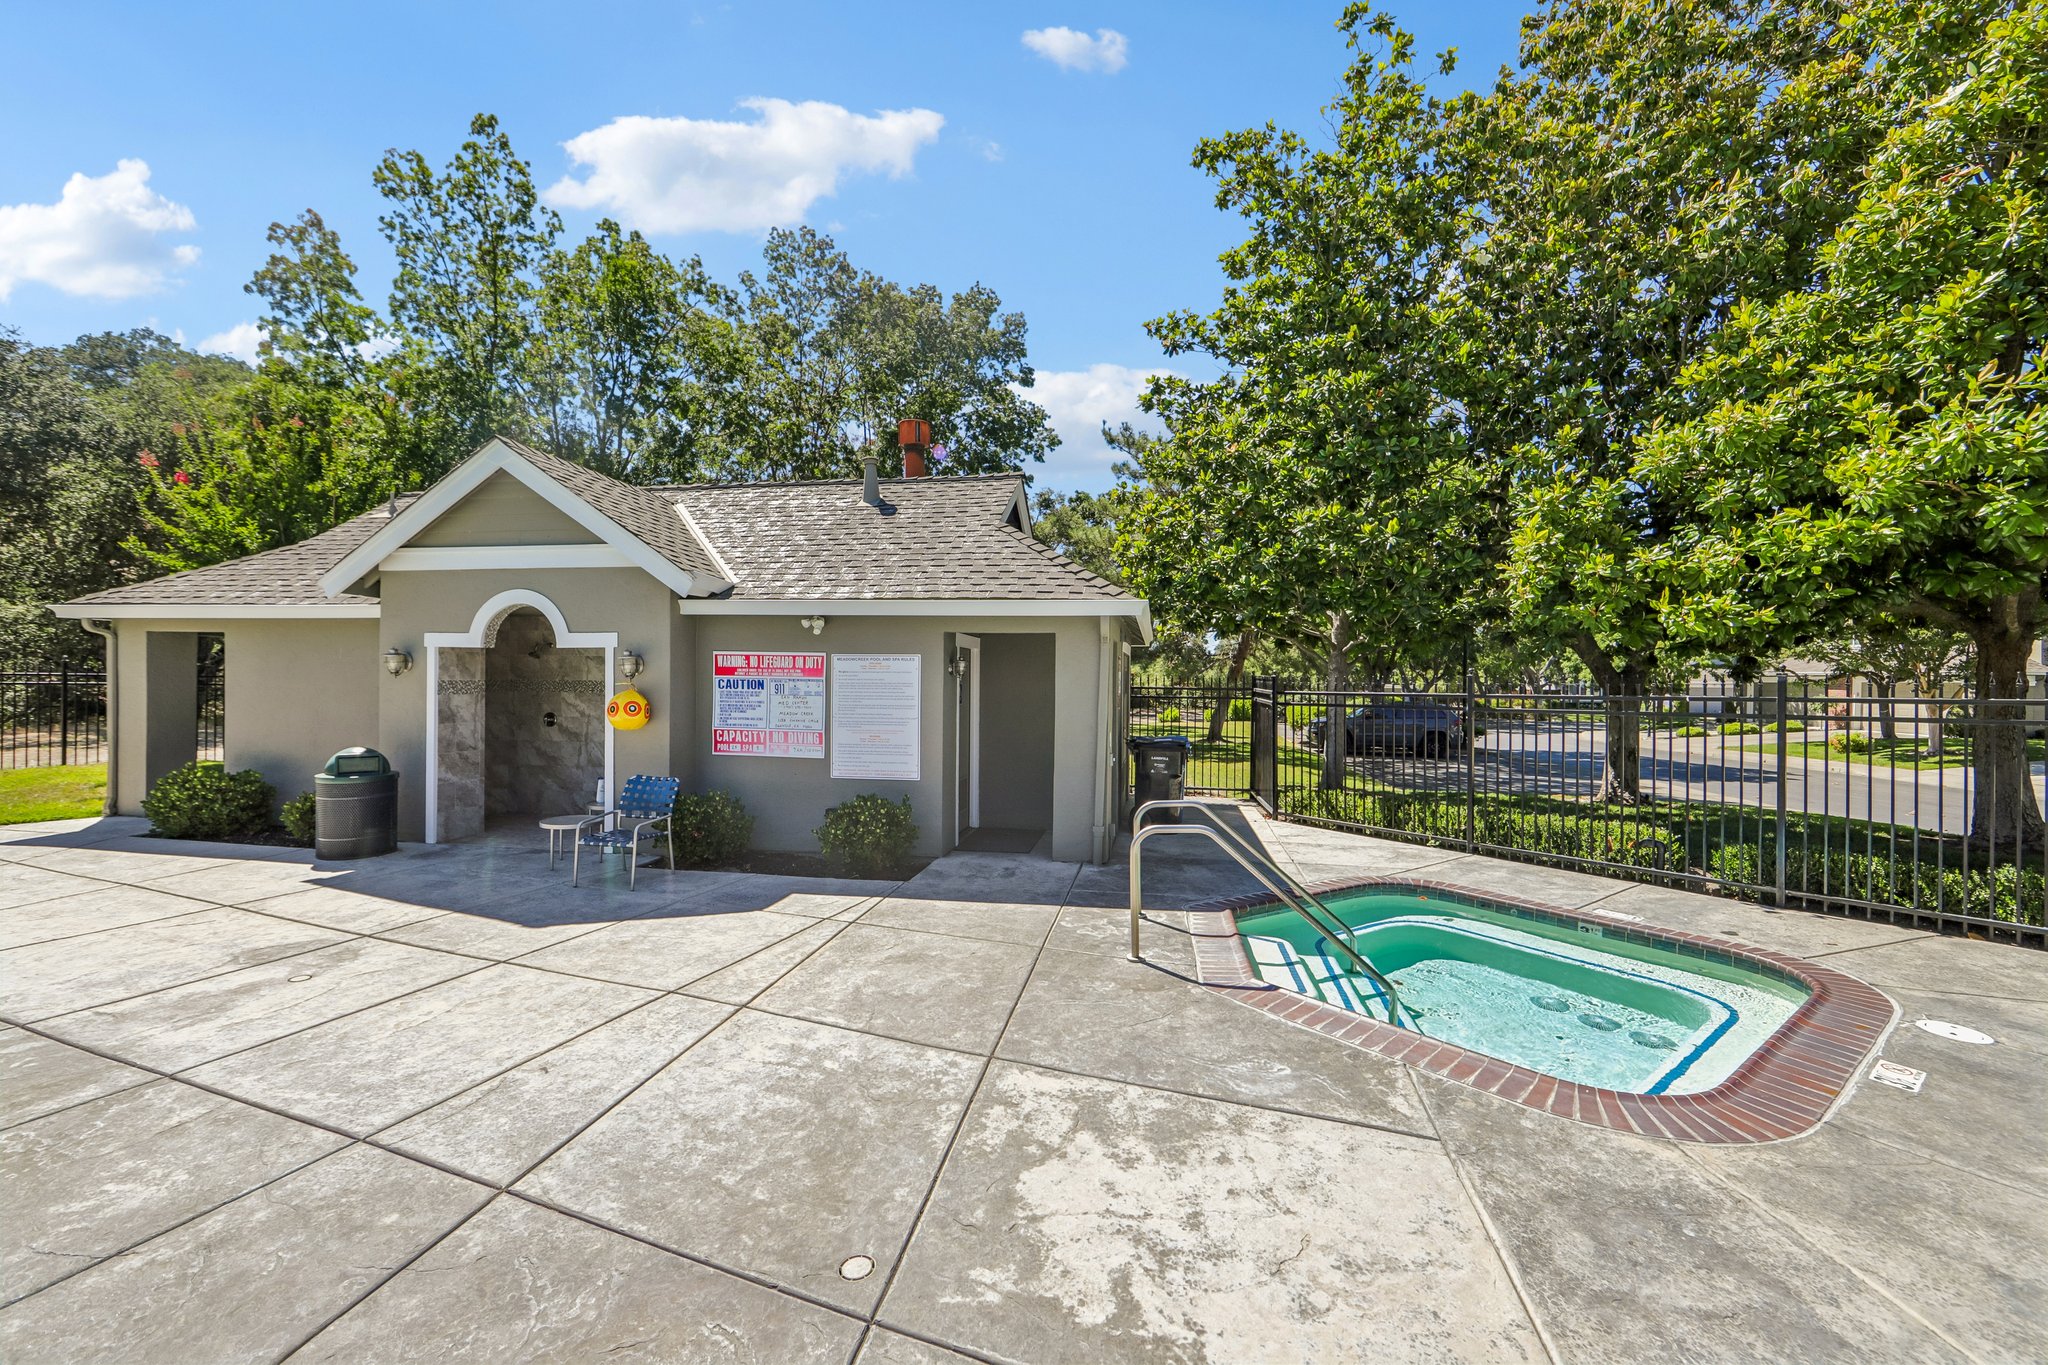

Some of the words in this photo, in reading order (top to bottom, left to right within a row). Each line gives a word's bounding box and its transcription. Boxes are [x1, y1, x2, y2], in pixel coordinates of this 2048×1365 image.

[717, 655, 748, 667] WARNING:
[749, 655, 758, 668] NO
[760, 656, 794, 668] LIFEGUARD
[795, 656, 804, 668] ON
[805, 656, 822, 669] DUTY
[718, 678, 765, 690] CAUTION
[774, 683, 785, 694] 911
[716, 730, 765, 743] CAPACITY
[772, 732, 784, 743] NO
[788, 732, 819, 744] DIVING
[717, 743, 730, 751] POOL
[742, 744, 752, 752] SPA
